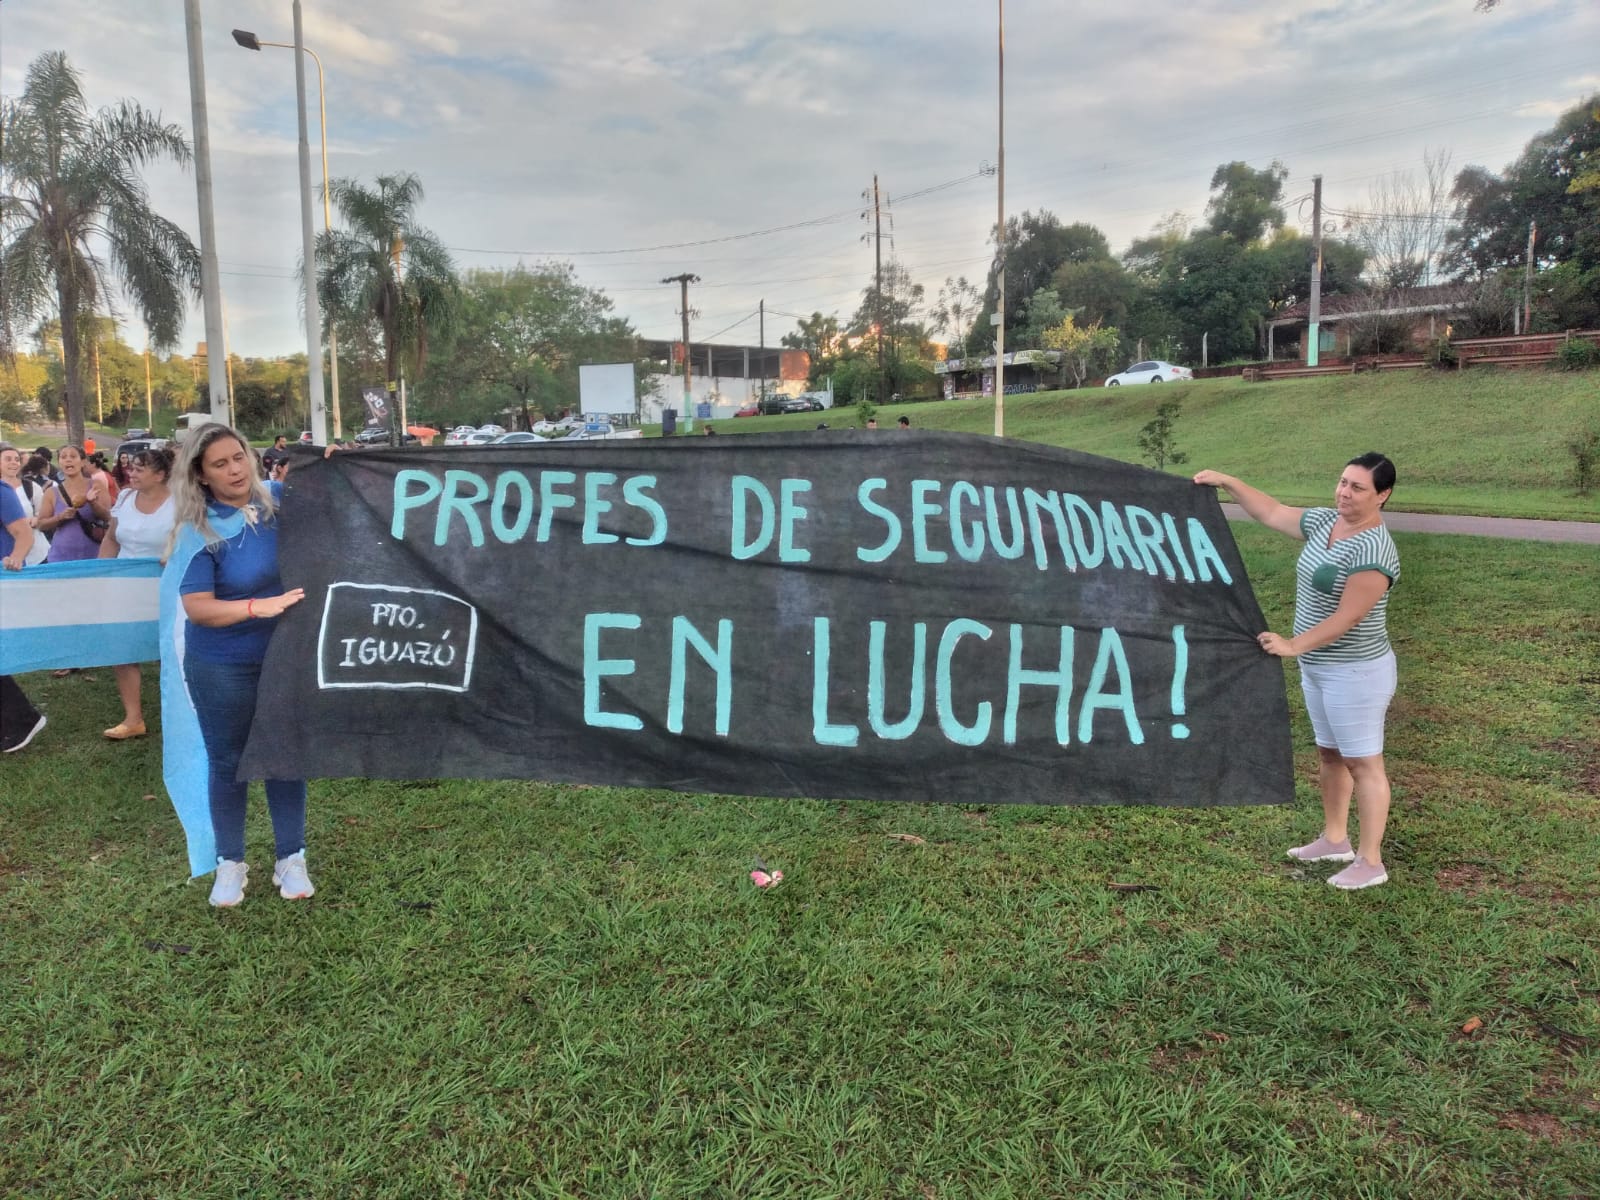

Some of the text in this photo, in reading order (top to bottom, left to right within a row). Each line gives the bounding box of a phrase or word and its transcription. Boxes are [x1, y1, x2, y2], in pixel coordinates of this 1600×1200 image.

[391, 469, 1233, 585] PROFES DE SECUNDARIA
[338, 629, 456, 667] IGUAZÚ
[371, 603, 425, 629] PTO.
[583, 612, 734, 737] EN
